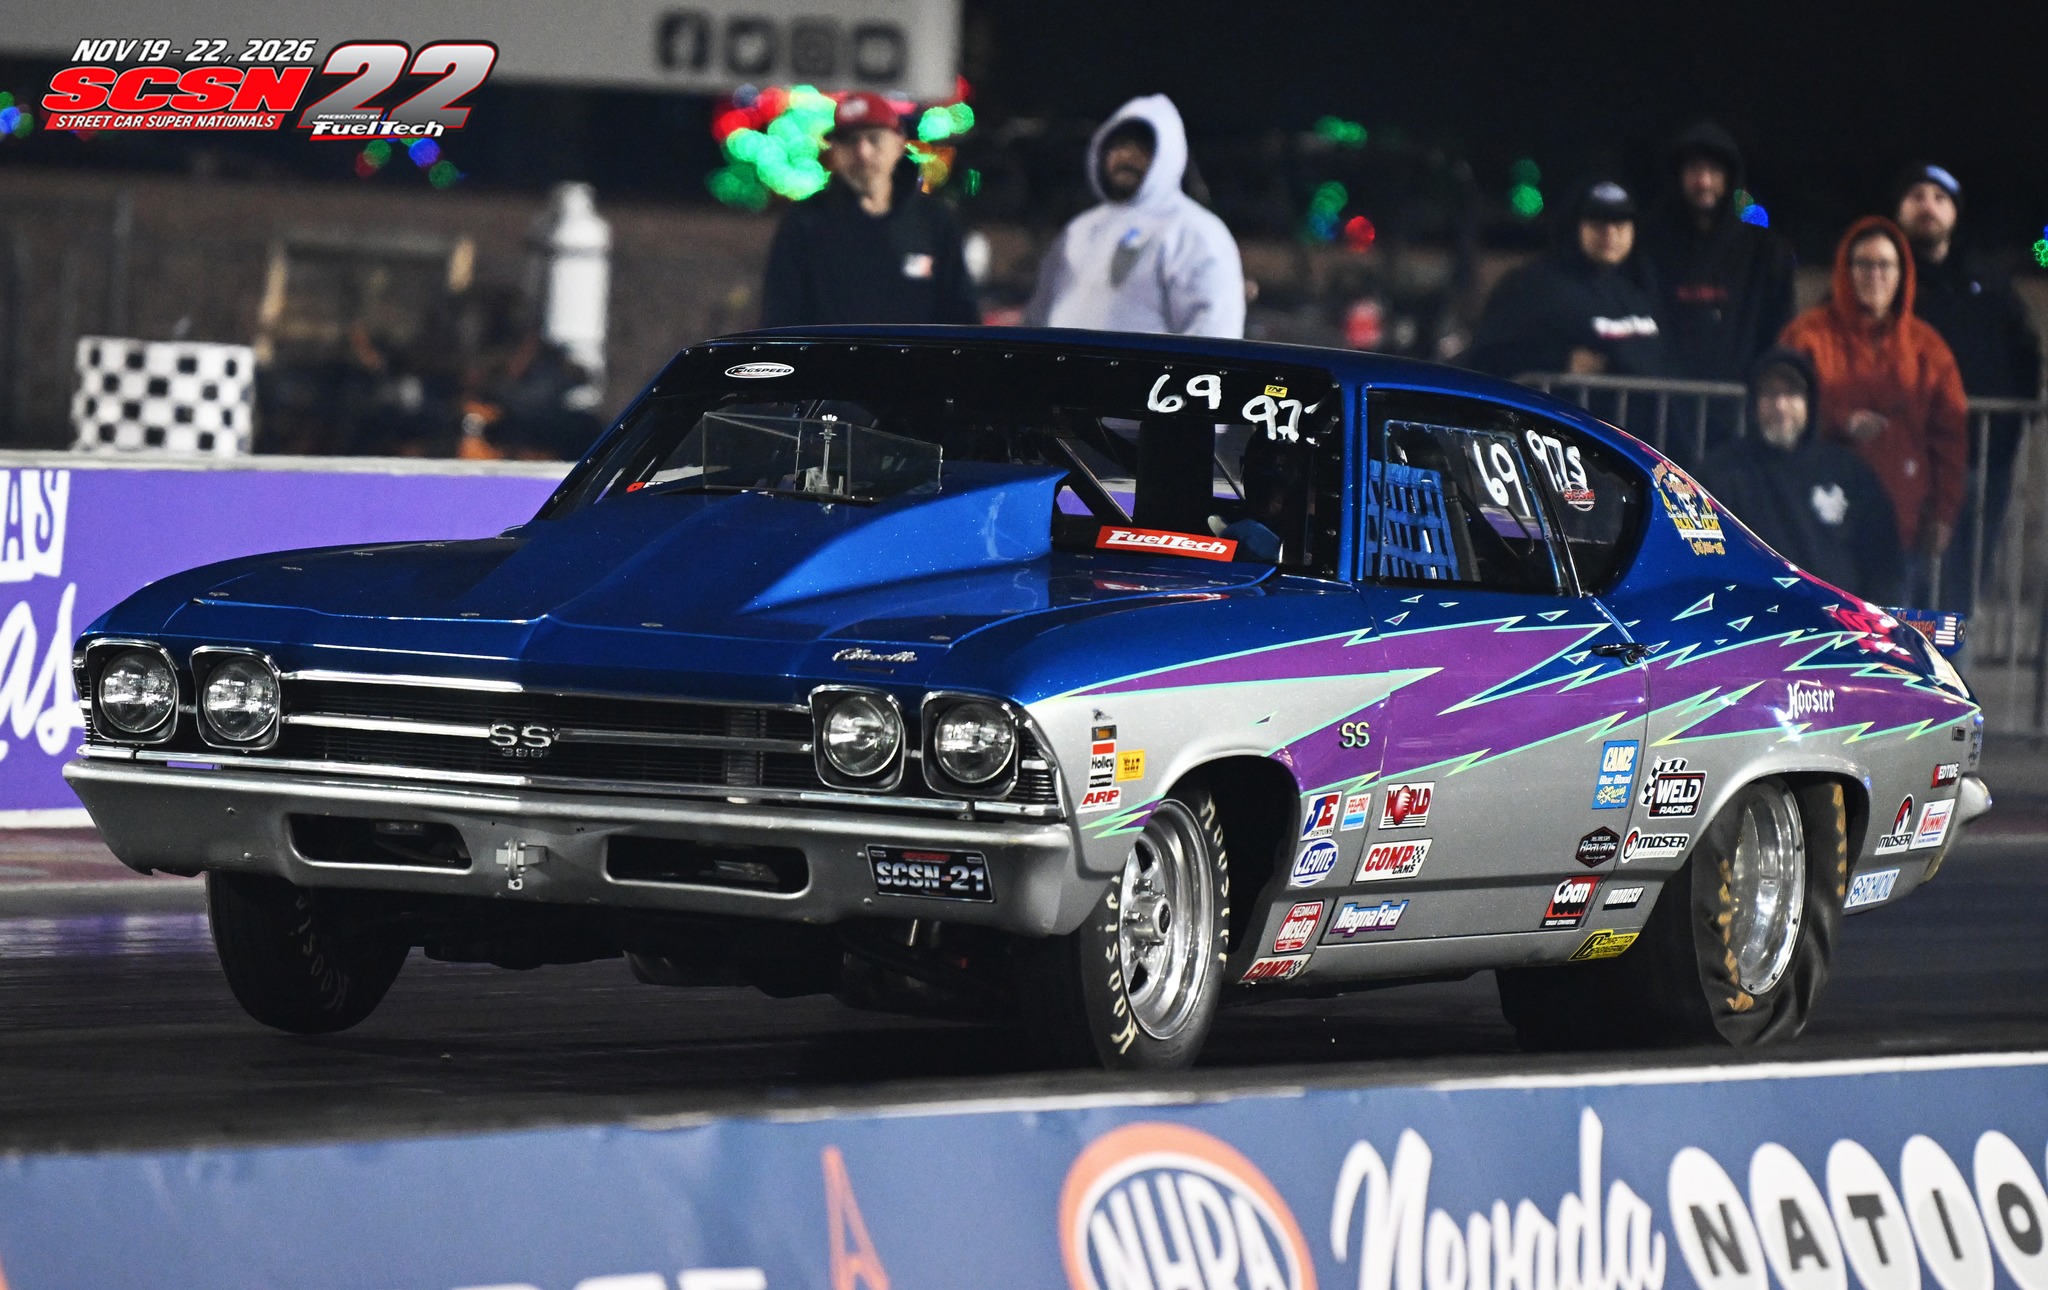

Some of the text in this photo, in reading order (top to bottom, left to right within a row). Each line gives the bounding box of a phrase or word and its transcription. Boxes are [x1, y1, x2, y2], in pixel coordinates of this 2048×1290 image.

[1147, 373, 1222, 414] 69
[1473, 440, 1532, 518] 69
[1105, 530, 1228, 555] FuelTech
[1786, 680, 1836, 720] Hoosier
[488, 724, 553, 748] SS
[1339, 721, 1371, 749] SS
[501, 747, 544, 758] 396
[1091, 755, 1115, 772] Holley
[1598, 773, 1633, 786] Blue Blood
[1656, 778, 1701, 804] WELD
[1081, 789, 1120, 805] ARP
[1658, 804, 1693, 815] RACING
[1303, 794, 1340, 836] JE
[1310, 829, 1333, 837] PISTONS
[1636, 835, 1689, 849] MOSER
[1878, 834, 1914, 848] MOSER
[1294, 848, 1336, 876] CLEVITE
[1364, 845, 1415, 872] COMP
[1633, 849, 1678, 857] ENGINEERING
[1391, 864, 1416, 875] CAMS
[1553, 879, 1592, 904] Coan
[1291, 904, 1321, 918] HEDMAN
[1333, 904, 1406, 933] MagnaFuel
[1331, 1105, 1667, 1290] Nevada
[1090, 1171, 1290, 1290] NHRA
